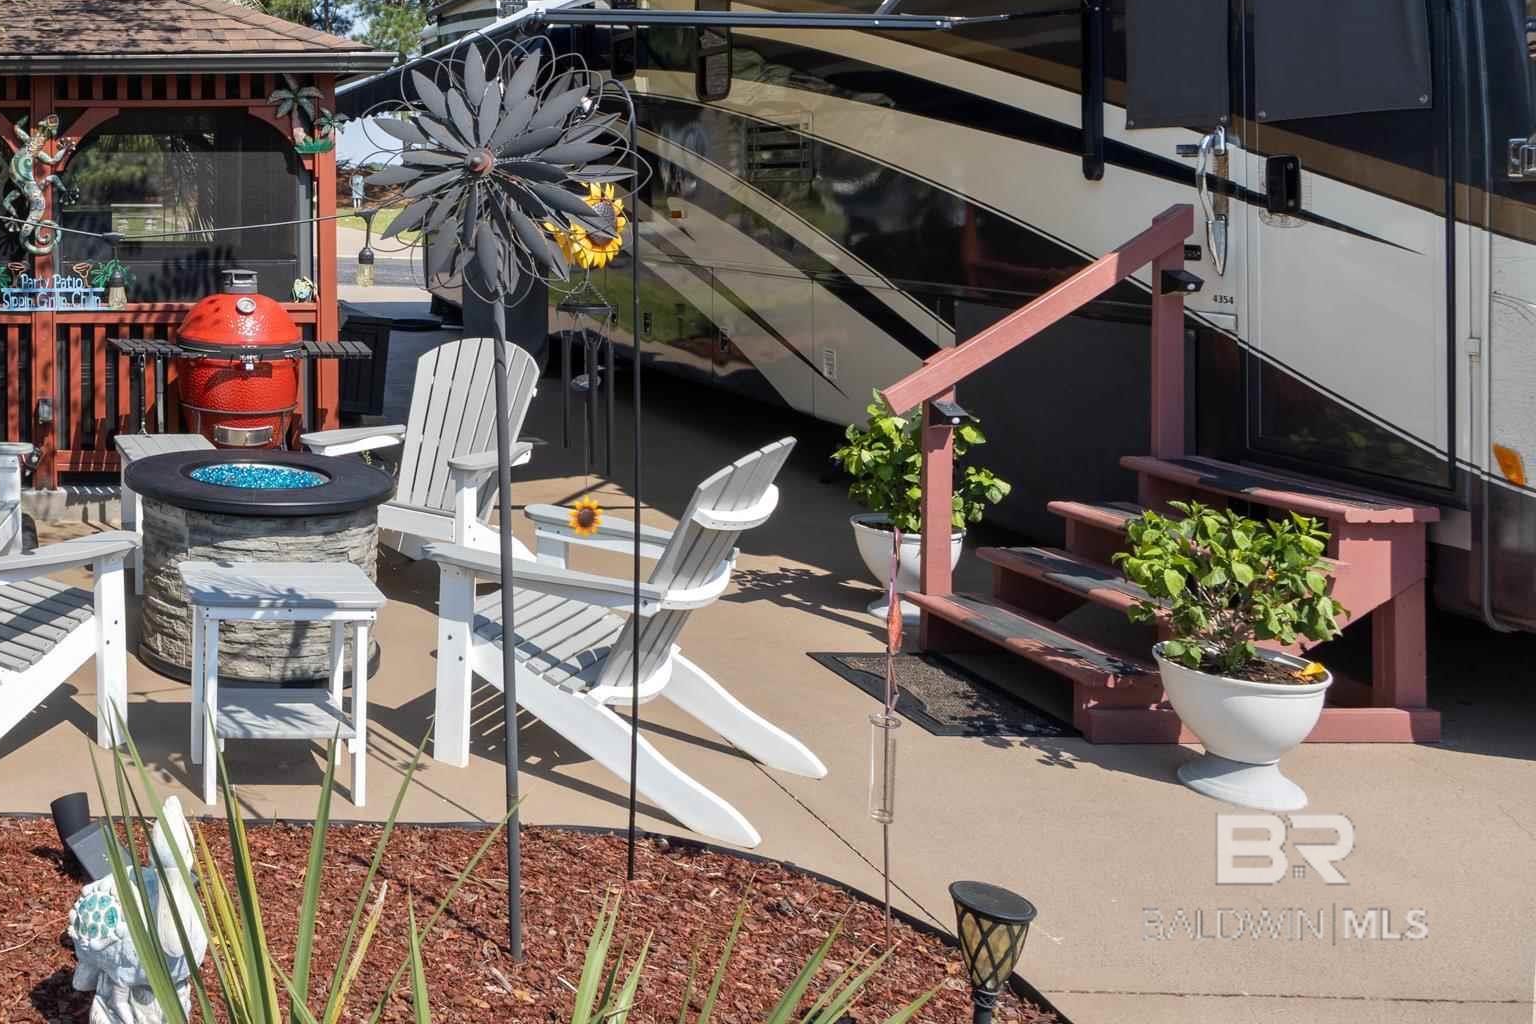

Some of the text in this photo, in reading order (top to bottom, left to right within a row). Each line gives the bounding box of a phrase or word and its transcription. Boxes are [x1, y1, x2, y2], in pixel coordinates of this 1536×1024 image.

[20, 273, 84, 289] Party Patio
[1212, 294, 1234, 305] 4354
